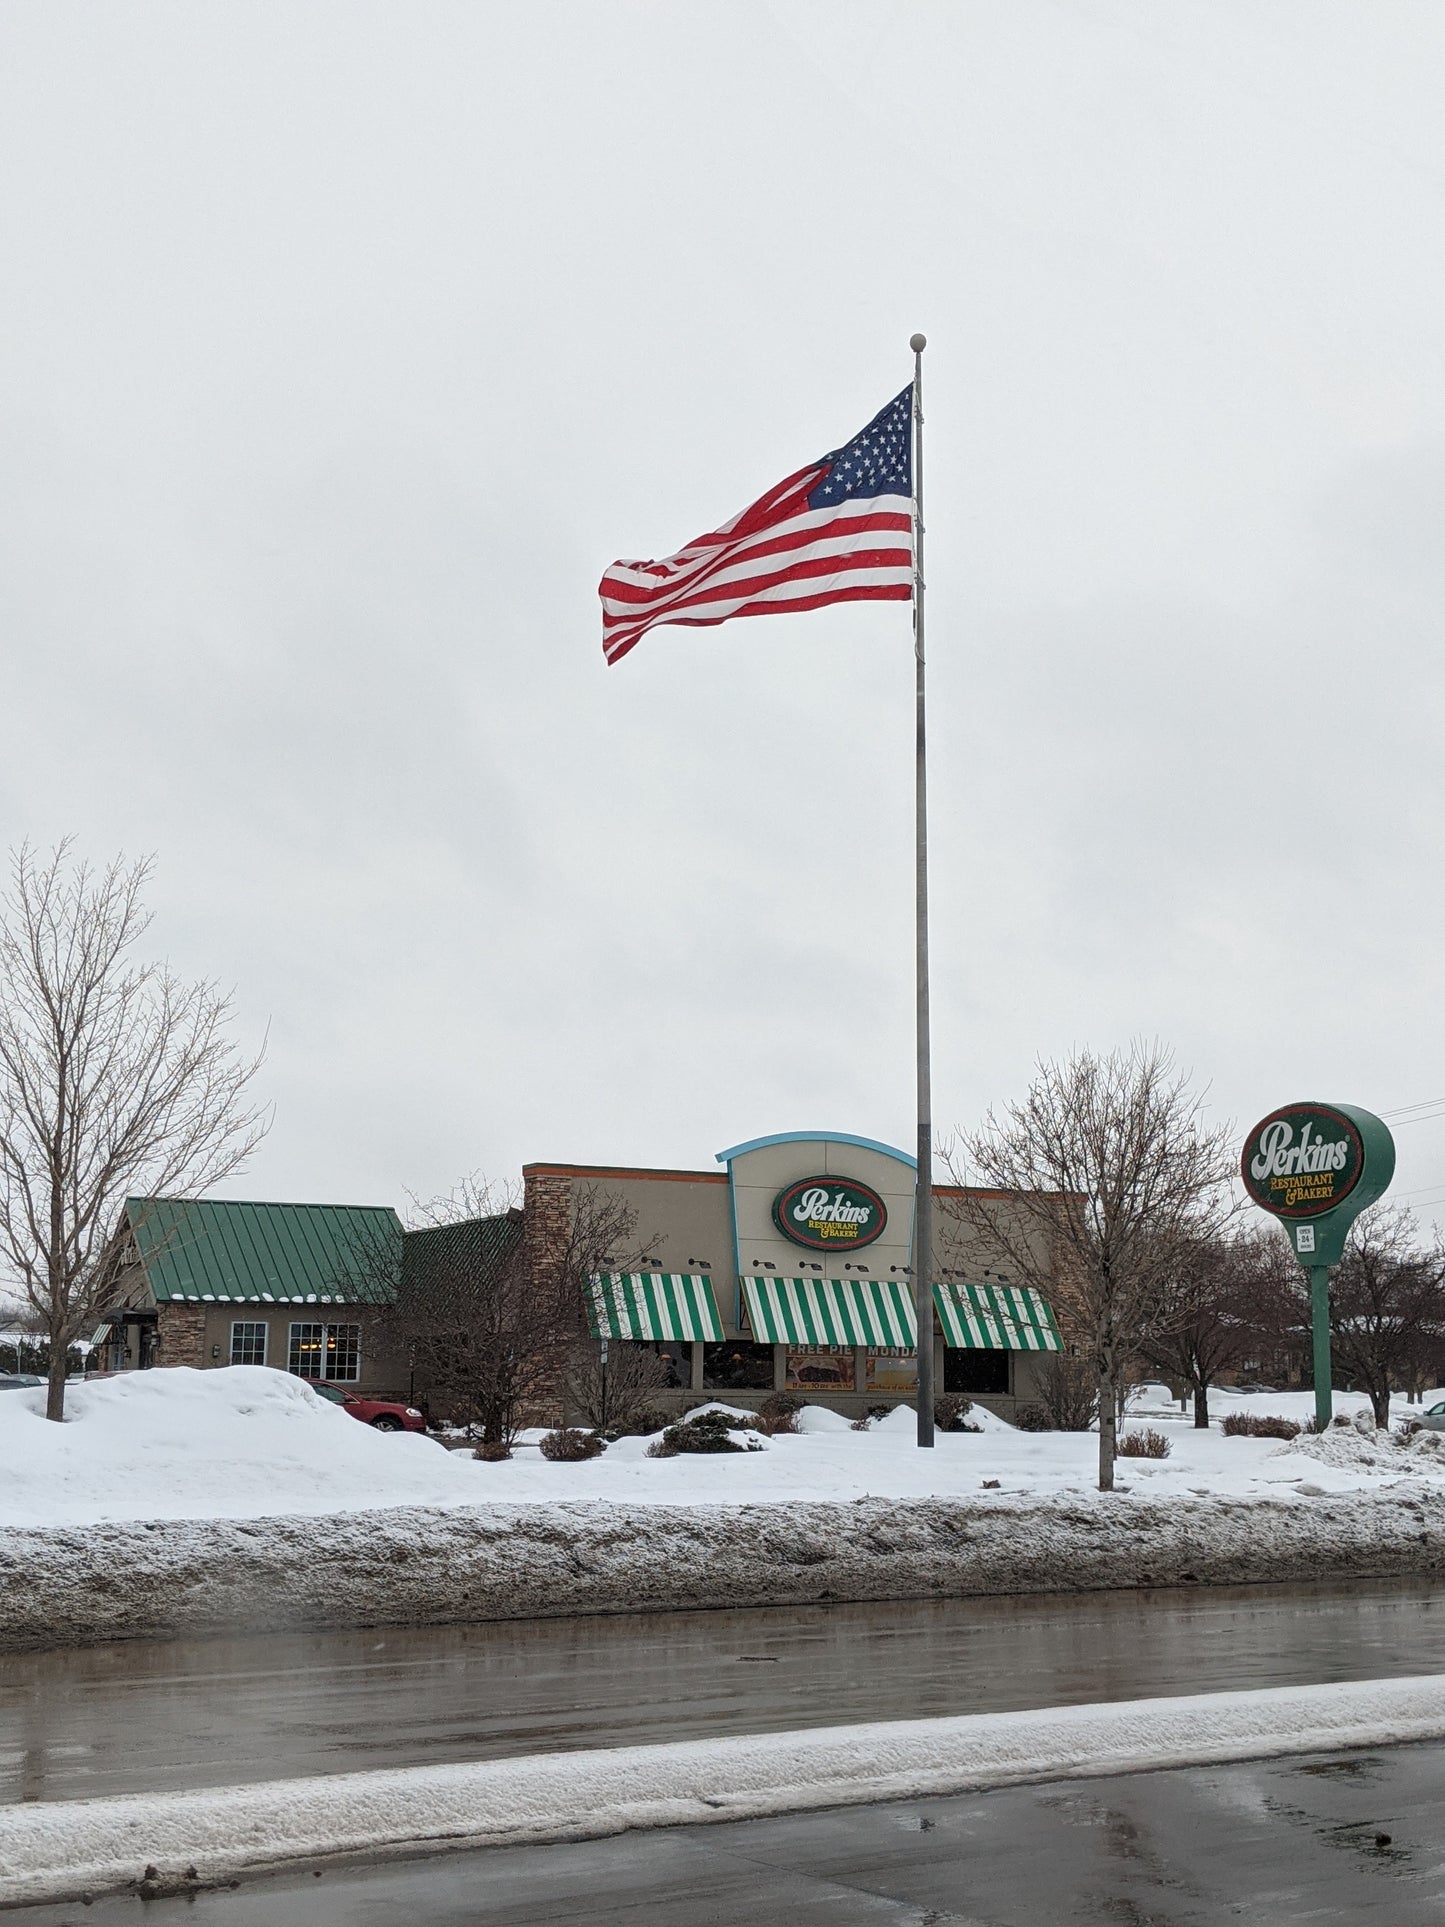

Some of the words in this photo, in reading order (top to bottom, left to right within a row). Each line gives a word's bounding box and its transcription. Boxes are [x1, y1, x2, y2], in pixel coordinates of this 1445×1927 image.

[1251, 1120, 1348, 1180] Perkins
[1270, 1173, 1334, 1190] RESTAURANT
[1296, 1186, 1334, 1201] BAKERY
[793, 1188, 870, 1224] Perkins
[808, 1220, 858, 1231] RESTAURANT
[829, 1229, 858, 1238] BAKERY
[788, 1344, 824, 1355] FREE
[829, 1344, 852, 1355] PIE
[867, 1346, 918, 1357] MONDA
